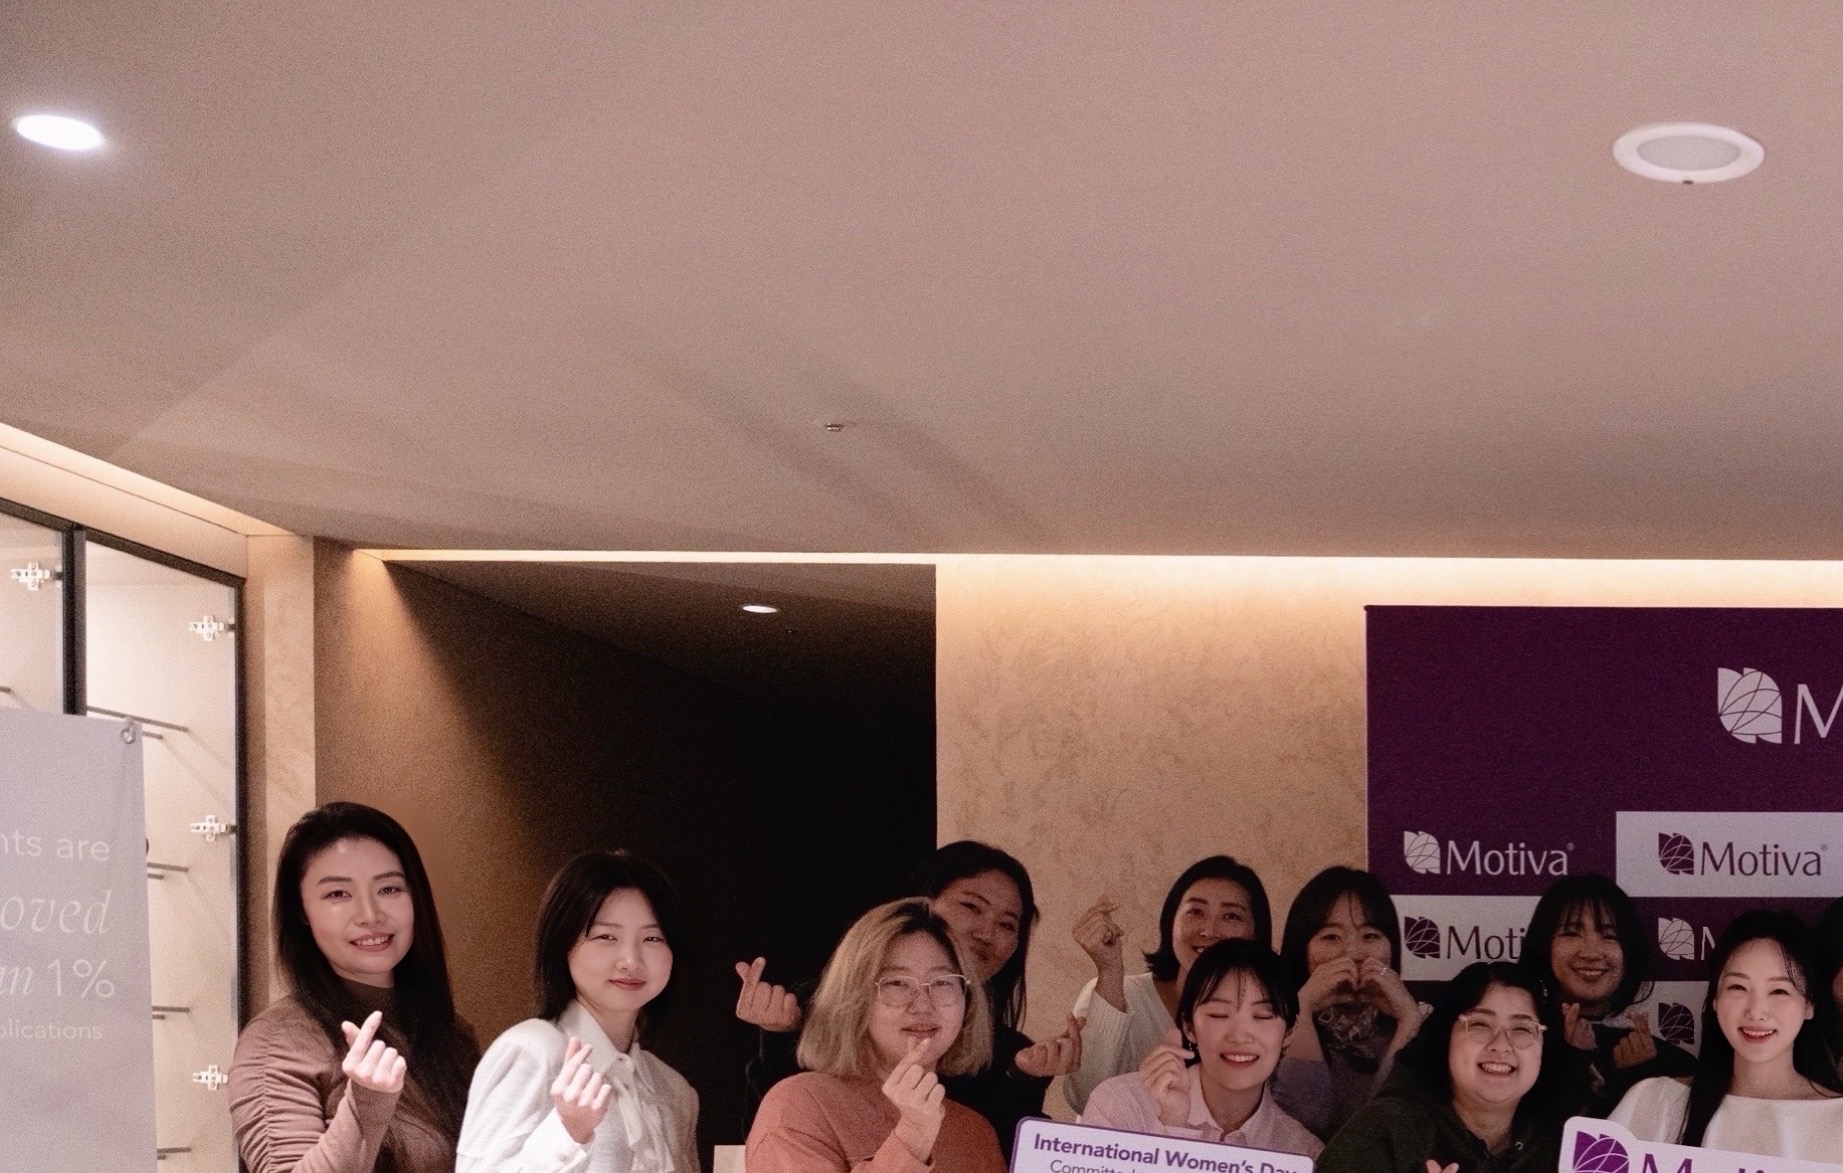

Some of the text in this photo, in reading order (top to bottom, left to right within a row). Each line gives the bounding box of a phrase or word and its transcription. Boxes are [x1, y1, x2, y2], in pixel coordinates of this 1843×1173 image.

[56, 837, 110, 862] are
[0, 889, 112, 936] oved
[48, 958, 116, 999] 1%
[0, 1018, 104, 1041] lications
[1034, 1133, 1159, 1165] International
